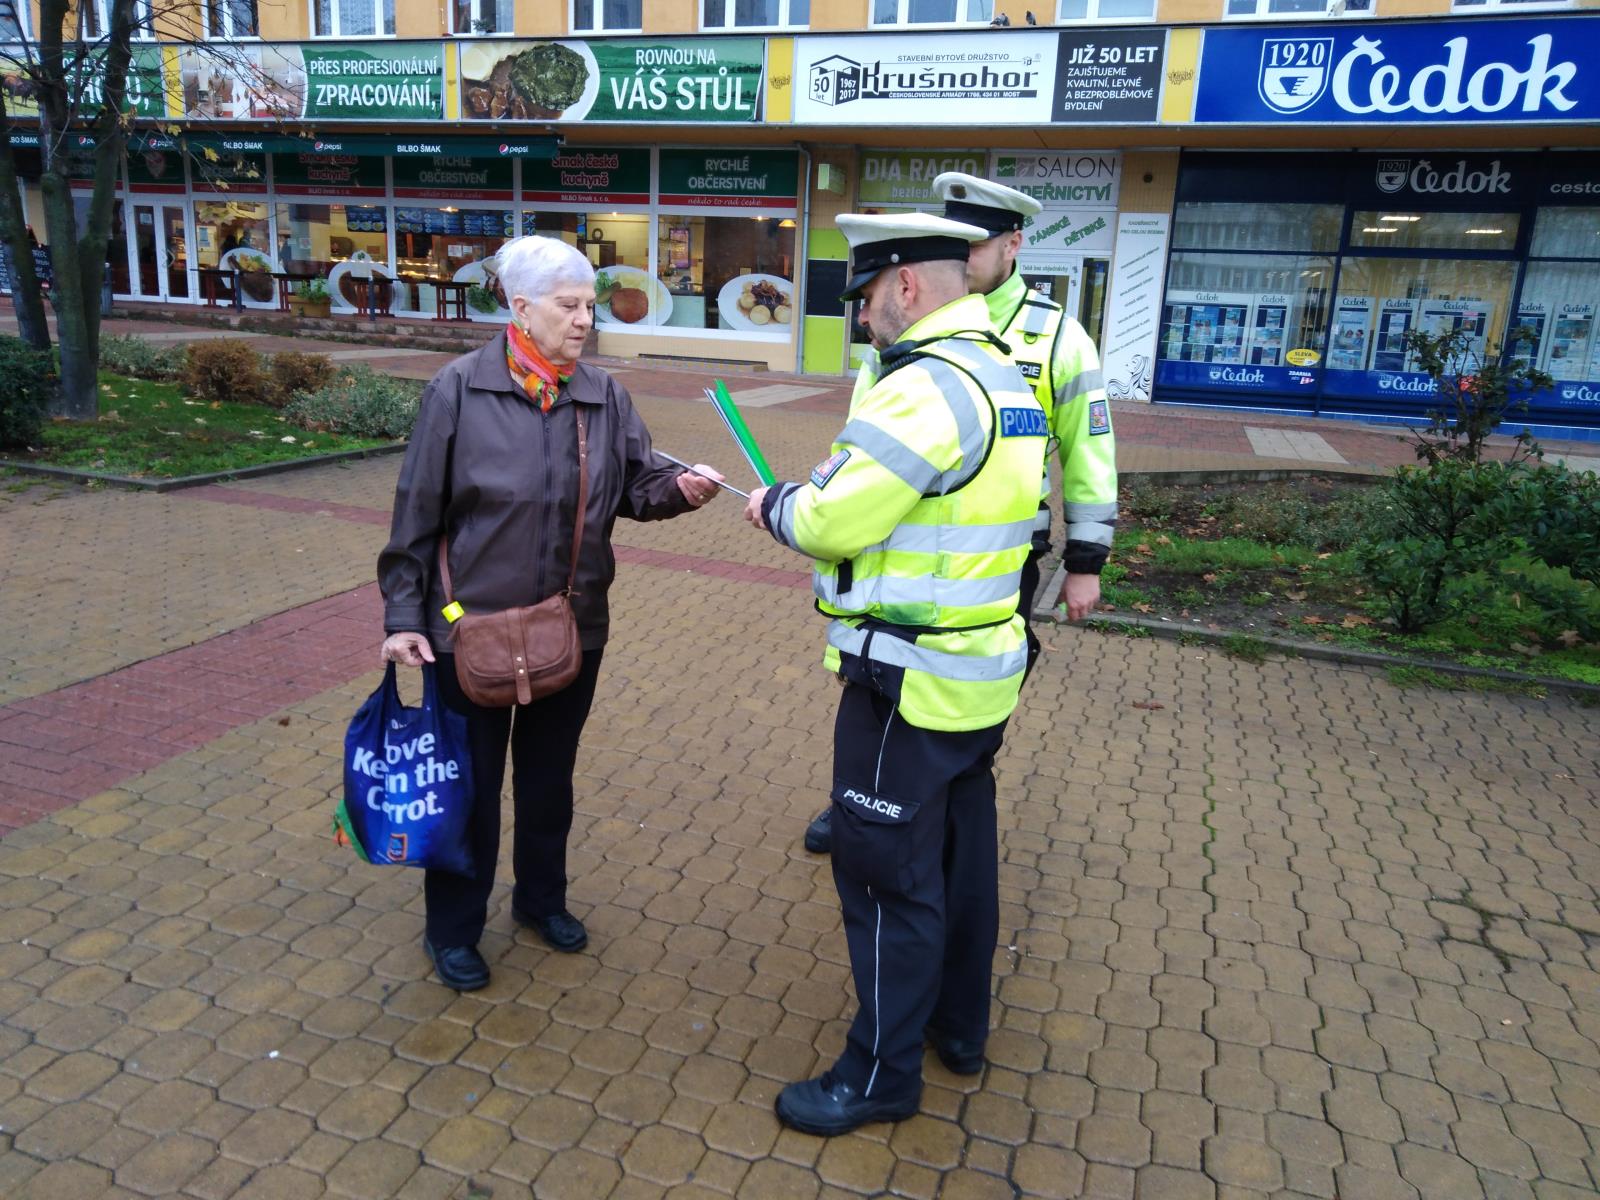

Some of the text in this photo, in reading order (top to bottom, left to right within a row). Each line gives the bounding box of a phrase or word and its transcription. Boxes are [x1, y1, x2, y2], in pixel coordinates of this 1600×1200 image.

[636, 48, 716, 65] ROVNOU NA
[897, 52, 1010, 62] STAVEBNÍ BYTOVÉ DRUŽSTVO
[1069, 44, 1158, 64] JIŽ 50 LET
[1268, 41, 1325, 67] 1920
[310, 55, 437, 75] PŘES PROFESIONÁLNÍ
[1067, 65, 1127, 77] ZAJIŠŤUJEME
[1332, 33, 1578, 114] Čedok
[813, 76, 830, 93] 50
[840, 78, 856, 89] 1967
[862, 60, 1039, 95] Krušnohor
[1066, 76, 1142, 89] KVALITNÍ, LEVNÉ
[315, 78, 437, 110] ZPRACOVÁNÍ,
[610, 67, 750, 111] VÁŠ STŮL
[815, 93, 825, 101] let
[839, 89, 856, 100] 2017
[888, 91, 941, 99] ČESKOSLOVENSKÉ
[1065, 88, 1153, 99] A BEZPROBLÉMOVÉ
[1065, 100, 1103, 111] BYDLENÍ
[323, 143, 342, 151] pepsi
[397, 143, 441, 153] BILBO ŠMAK
[509, 145, 528, 154] pepsi
[705, 156, 750, 171] RYCHLÉ
[865, 158, 901, 181] DIA
[1036, 156, 1116, 178] SALON
[561, 170, 609, 189] kuchyně
[688, 173, 768, 190] OBČERSTVENÍ
[1409, 159, 1512, 193] Čedok
[1028, 215, 1071, 246] PÁNSKÉ
[1063, 216, 1106, 247] DĚTSKÉ
[1222, 366, 1265, 383] Čedok
[1392, 375, 1439, 393] Čedok
[414, 757, 460, 787] the
[843, 789, 902, 819] POLICIE
